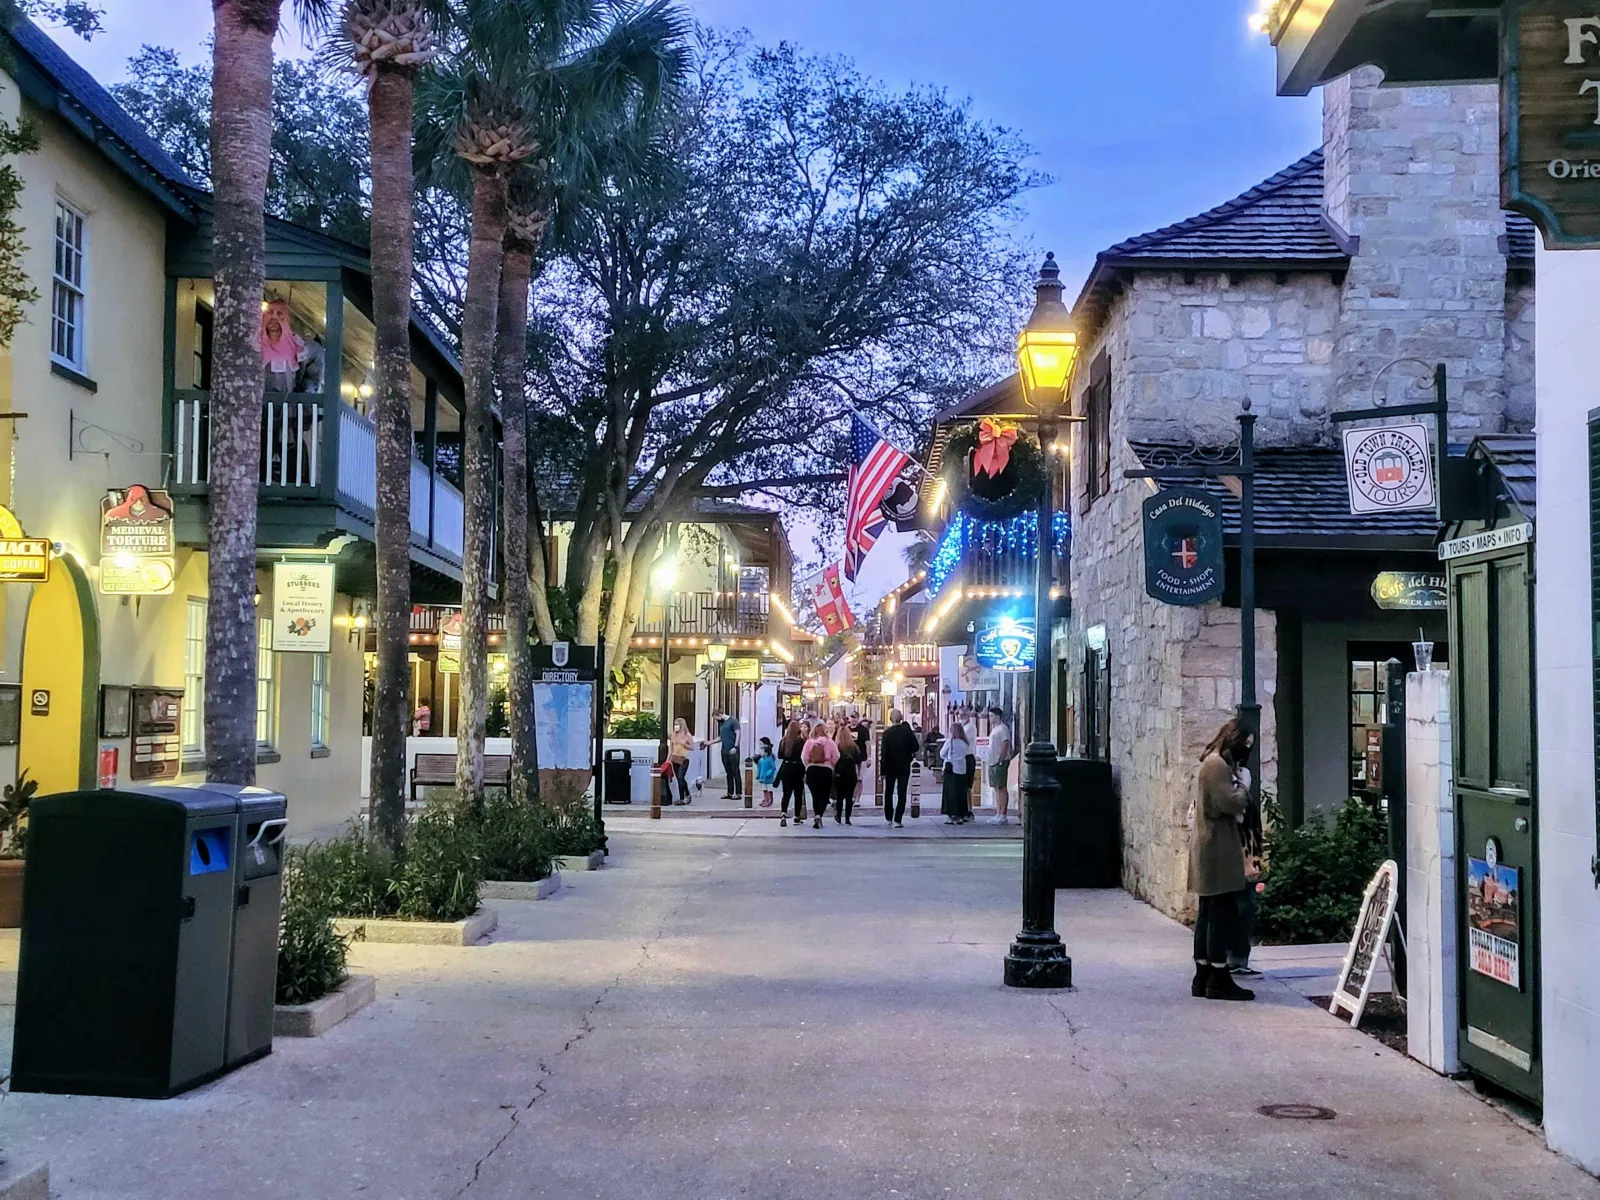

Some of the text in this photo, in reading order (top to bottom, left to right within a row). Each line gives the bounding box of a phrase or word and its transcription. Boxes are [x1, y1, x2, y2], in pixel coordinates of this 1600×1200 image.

[1355, 433, 1424, 478] OLD TOWN TROLLEY
[1367, 480, 1418, 503] TOURS
[1149, 496, 1215, 519] Casa Del Hidalgo
[107, 535, 167, 546] TORTURE
[111, 526, 165, 535] MEDIEVAL
[1448, 527, 1521, 555] TOURS MAPS INFO
[1156, 576, 1216, 595] ENTERTAINMENT
[1157, 566, 1214, 586] FOOD SHOPS
[1379, 575, 1448, 599] Café del Hi
[542, 671, 579, 682] DIRECTORY
